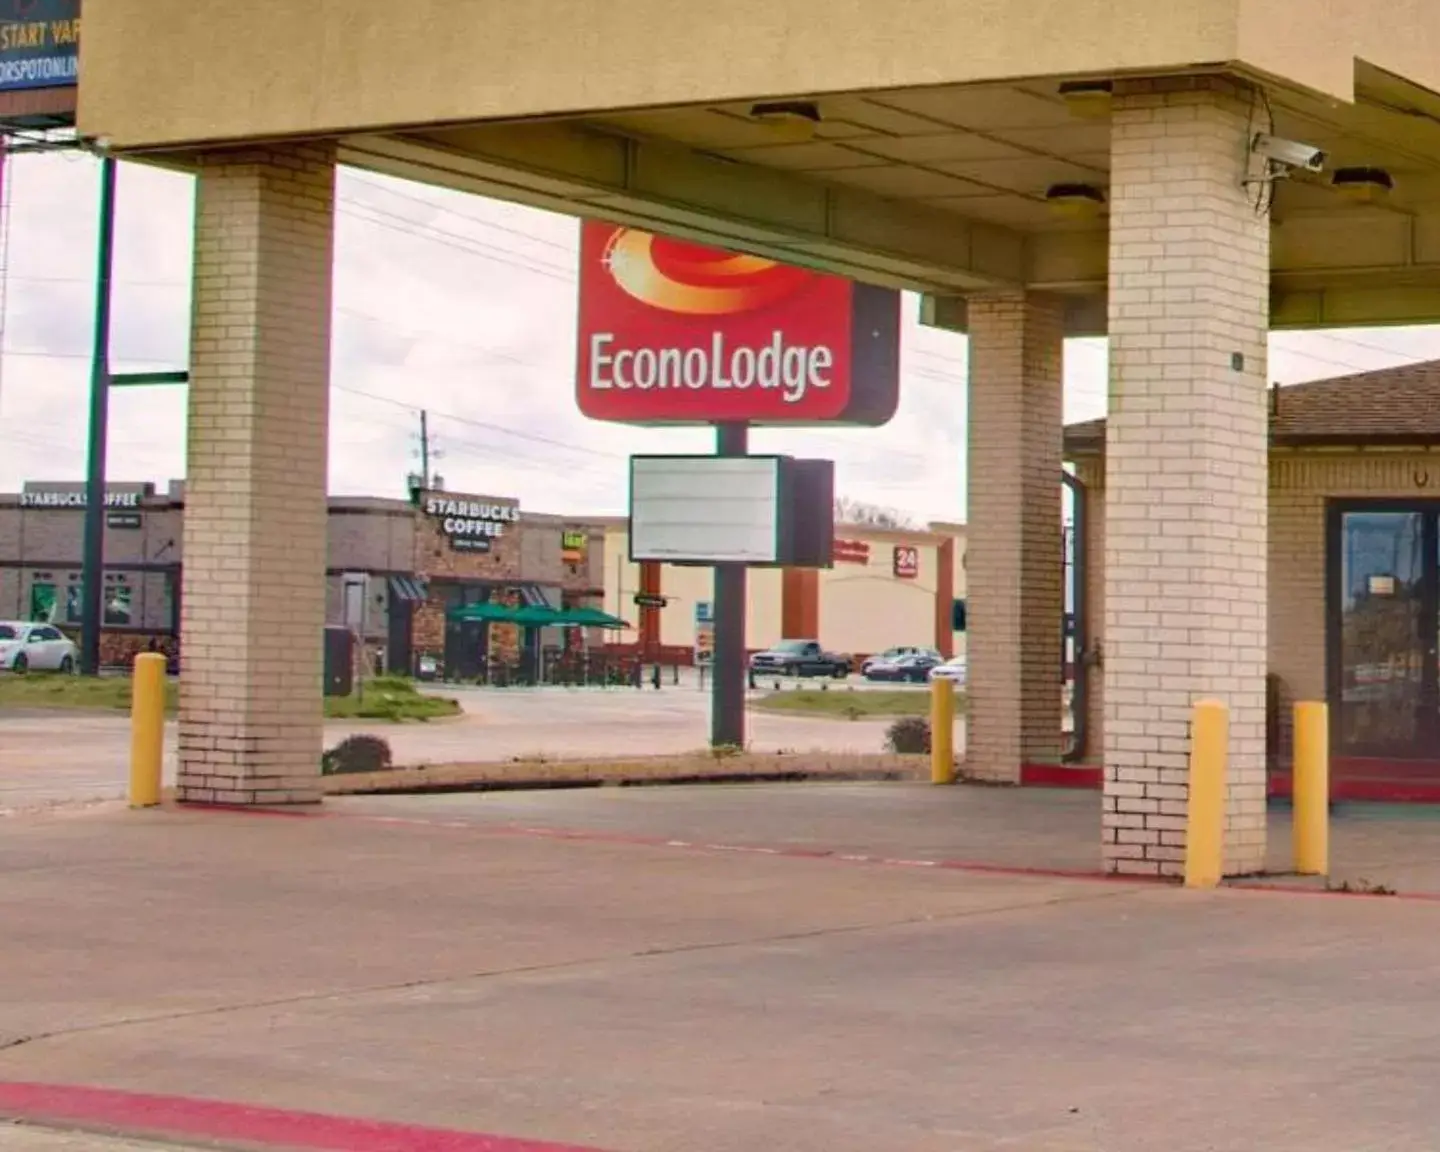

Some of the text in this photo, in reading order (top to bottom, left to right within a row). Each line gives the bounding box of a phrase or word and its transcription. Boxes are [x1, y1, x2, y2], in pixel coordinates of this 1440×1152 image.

[1, 22, 46, 49] START
[591, 330, 833, 403] EconoLodge
[426, 499, 520, 521] STARBUCKS
[443, 518, 503, 536] COFFEE
[897, 550, 916, 567] 24
